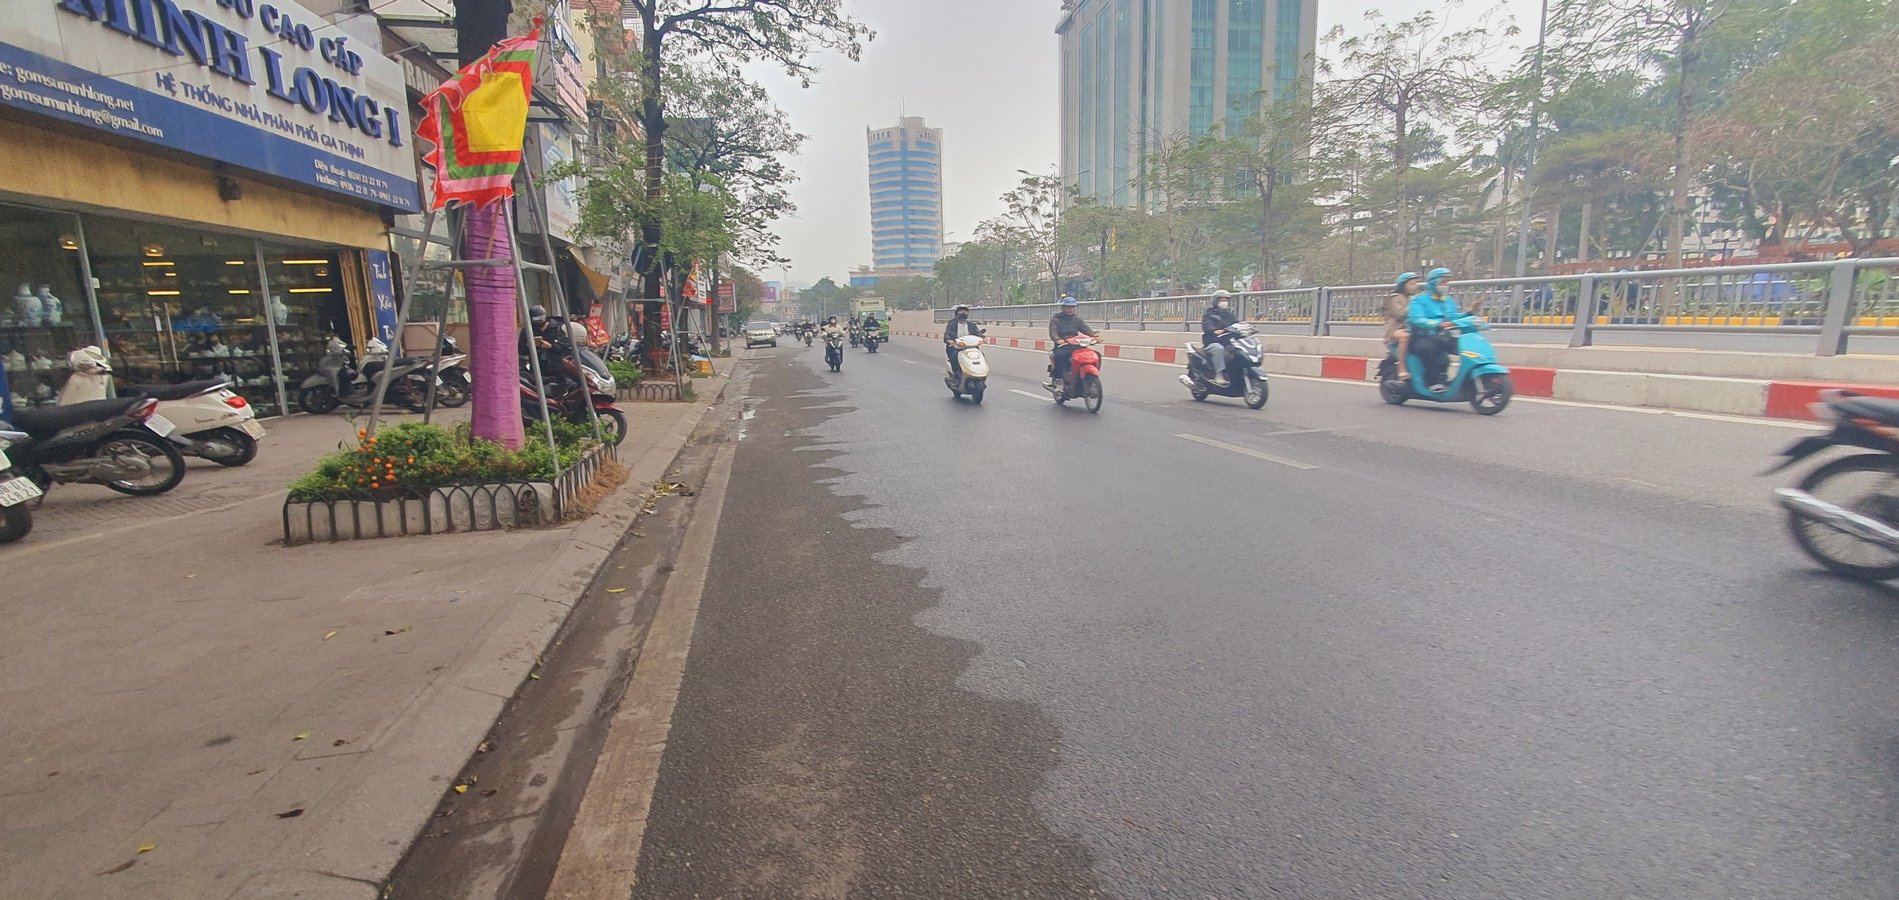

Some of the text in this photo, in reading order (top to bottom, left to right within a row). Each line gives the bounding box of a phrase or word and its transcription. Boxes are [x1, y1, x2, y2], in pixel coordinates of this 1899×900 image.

[260, 4, 314, 50] CAO
[320, 37, 363, 76] CẤP
[15, 66, 134, 112] gomsuminhlong.net
[156, 72, 365, 159] HỆ THỐNG NHÀ PHÂN PHỐI GIA THỊNH
[259, 46, 382, 138] LONG
[384, 107, 403, 148] I
